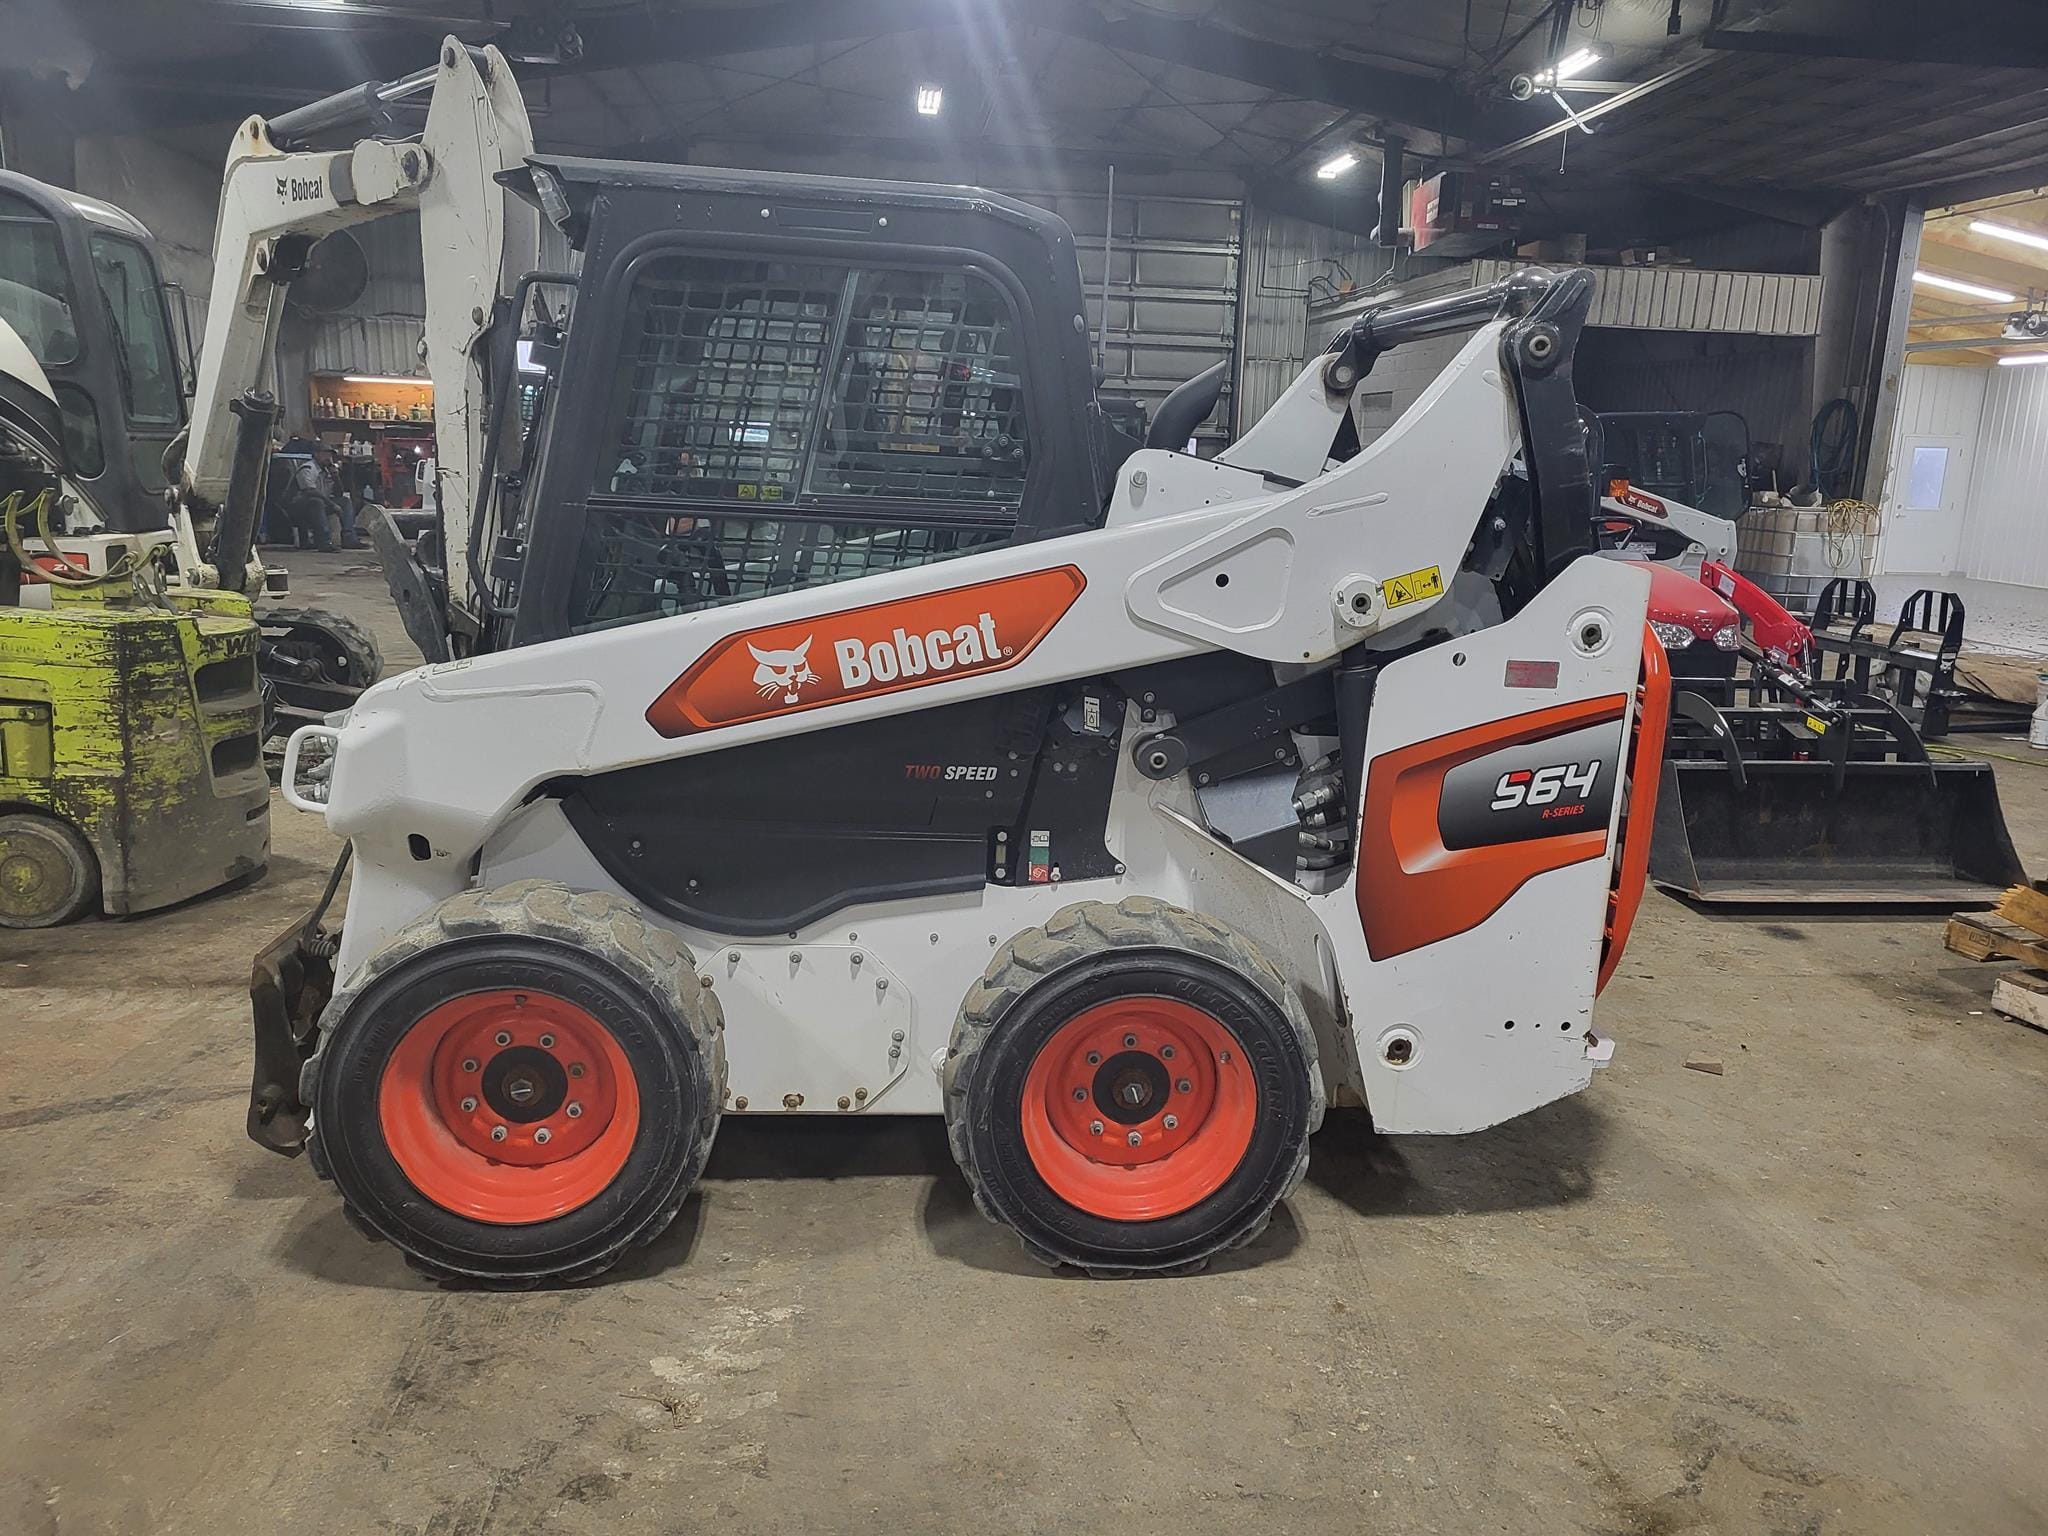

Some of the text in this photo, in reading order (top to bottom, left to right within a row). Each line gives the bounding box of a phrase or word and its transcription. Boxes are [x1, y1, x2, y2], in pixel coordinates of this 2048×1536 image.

[291, 175, 323, 201] Bobcat
[834, 612, 1001, 689] Bobcat
[905, 765, 998, 780] TWO SPEED
[1490, 761, 1600, 811] S64
[1542, 804, 1585, 819] R-SERIES
